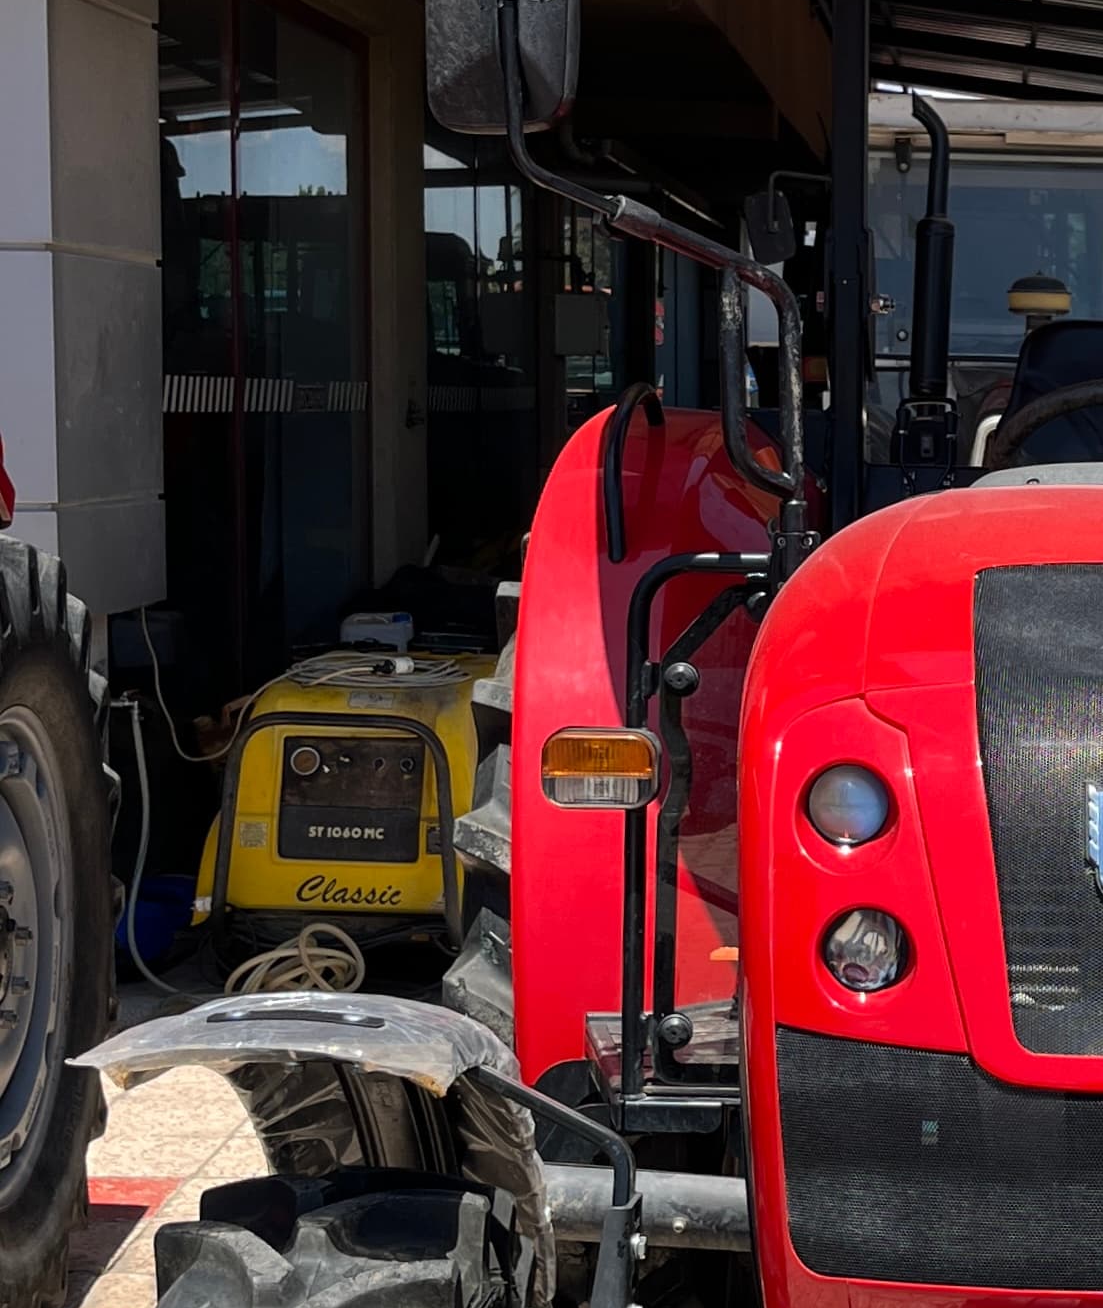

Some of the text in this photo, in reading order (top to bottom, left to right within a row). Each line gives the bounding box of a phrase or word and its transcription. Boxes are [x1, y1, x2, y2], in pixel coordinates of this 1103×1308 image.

[308, 826, 384, 839] ST 1060 MC
[296, 874, 402, 906] Classic
